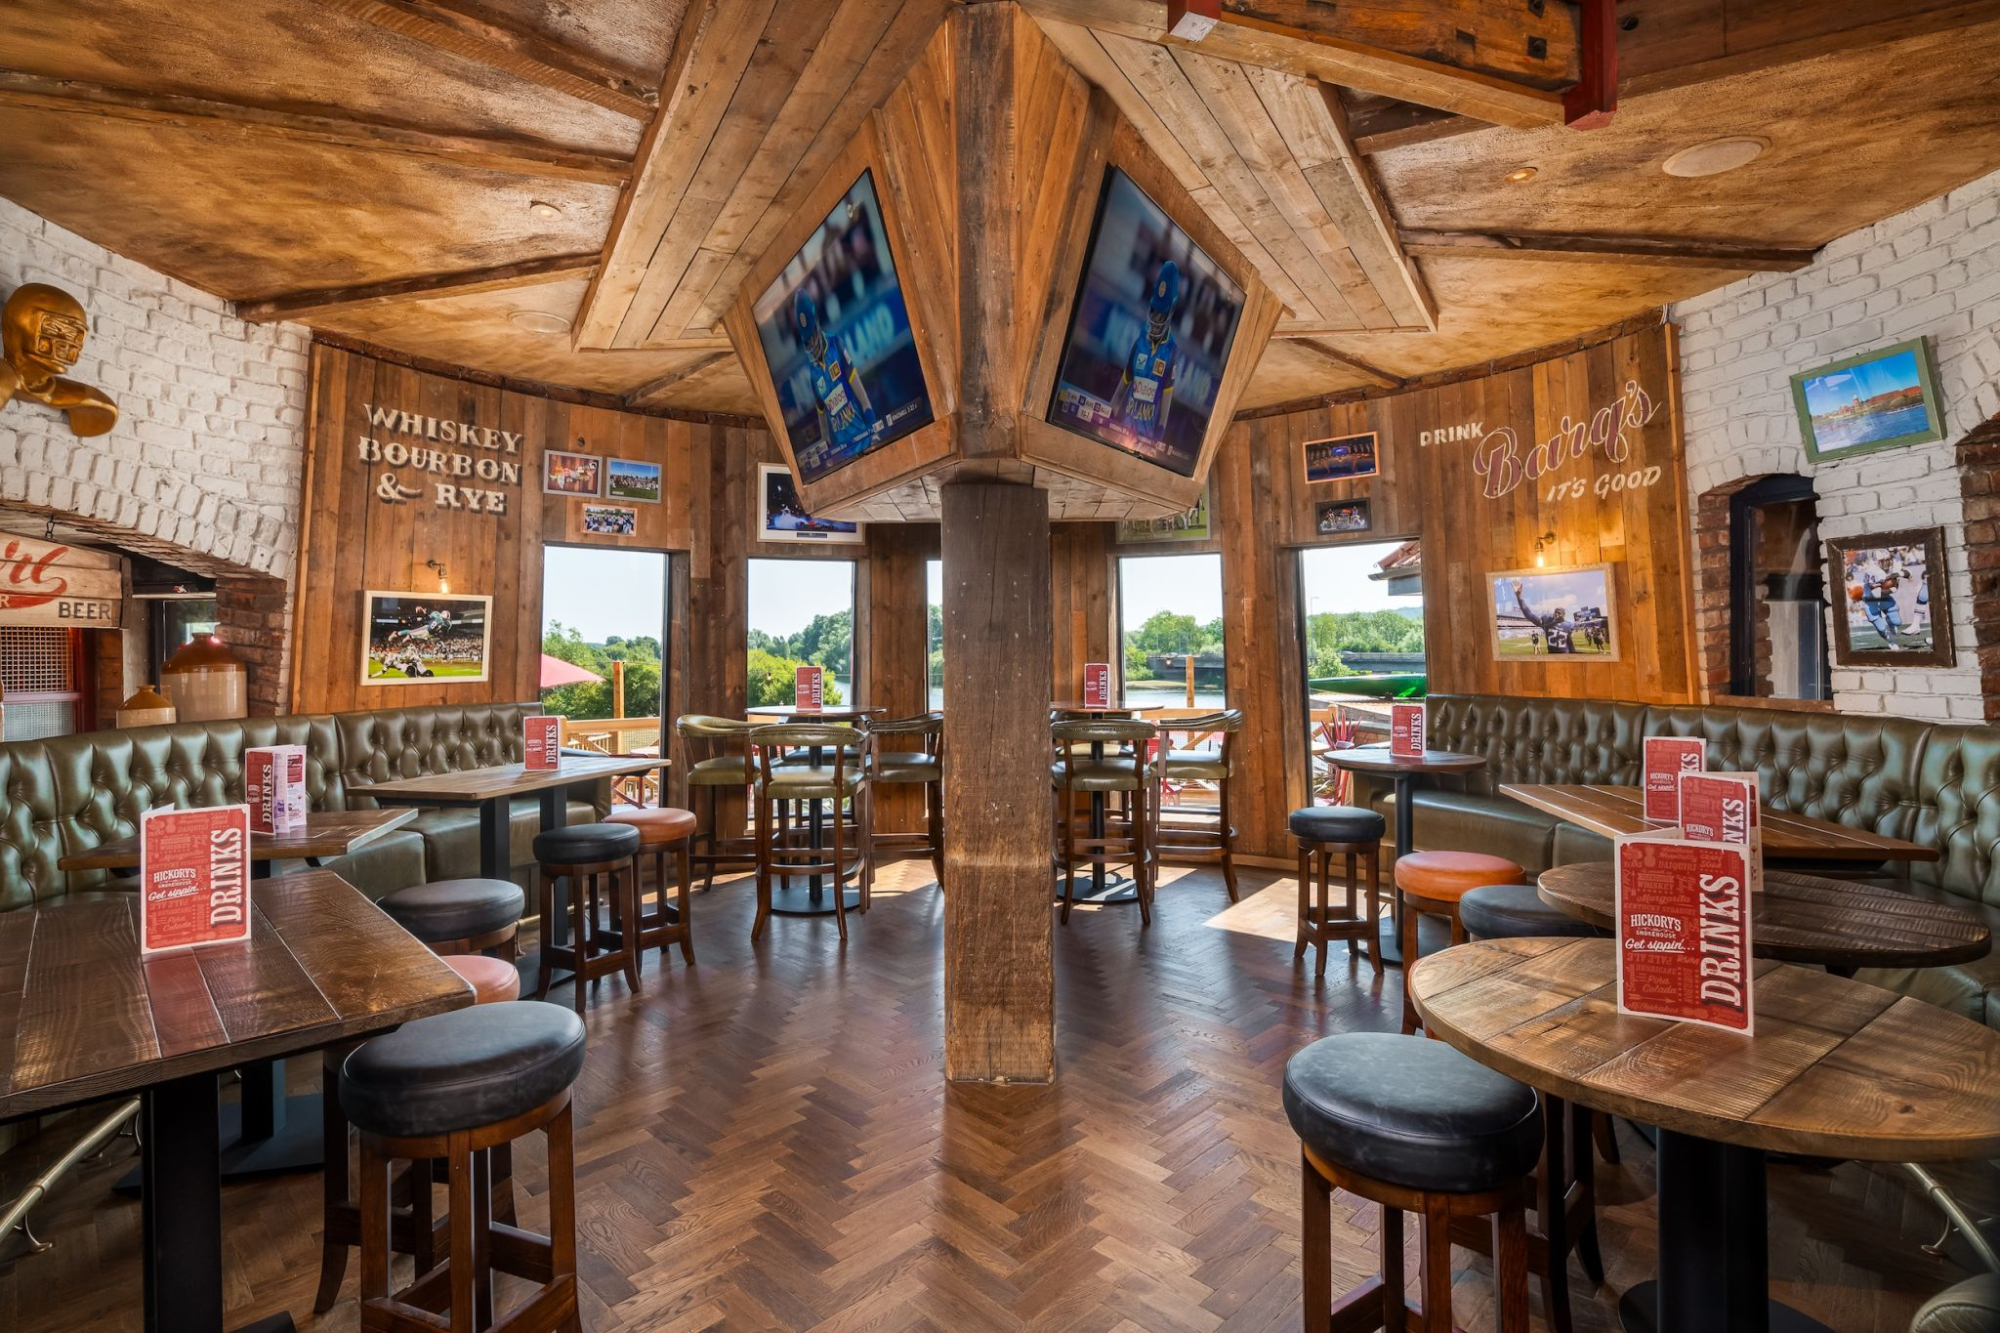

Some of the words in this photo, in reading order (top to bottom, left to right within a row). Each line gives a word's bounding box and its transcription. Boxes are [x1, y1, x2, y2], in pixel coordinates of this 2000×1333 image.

[363, 403, 523, 456] WHISKEY
[1420, 422, 1484, 447] DRINK
[1473, 380, 1661, 499] Barq's
[358, 435, 523, 486] BOURBON
[376, 472, 423, 504] &
[434, 482, 506, 514] RYE
[1547, 476, 1587, 501] IT'S
[1593, 465, 1662, 500] GOOD
[58, 601, 112, 620] BEER
[545, 725, 557, 764] DRINKS
[1410, 713, 1422, 751] DRINKS
[262, 764, 273, 824] DRINKS
[1722, 798, 1745, 844] NKS
[148, 890, 167, 901] Get
[210, 827, 242, 926] DRINKS
[1630, 913, 1682, 932] HICKORY'S
[1635, 930, 1677, 940] SMOKEHOUSE
[1699, 873, 1742, 1007] DRINKS
[1625, 937, 1646, 950] Get
